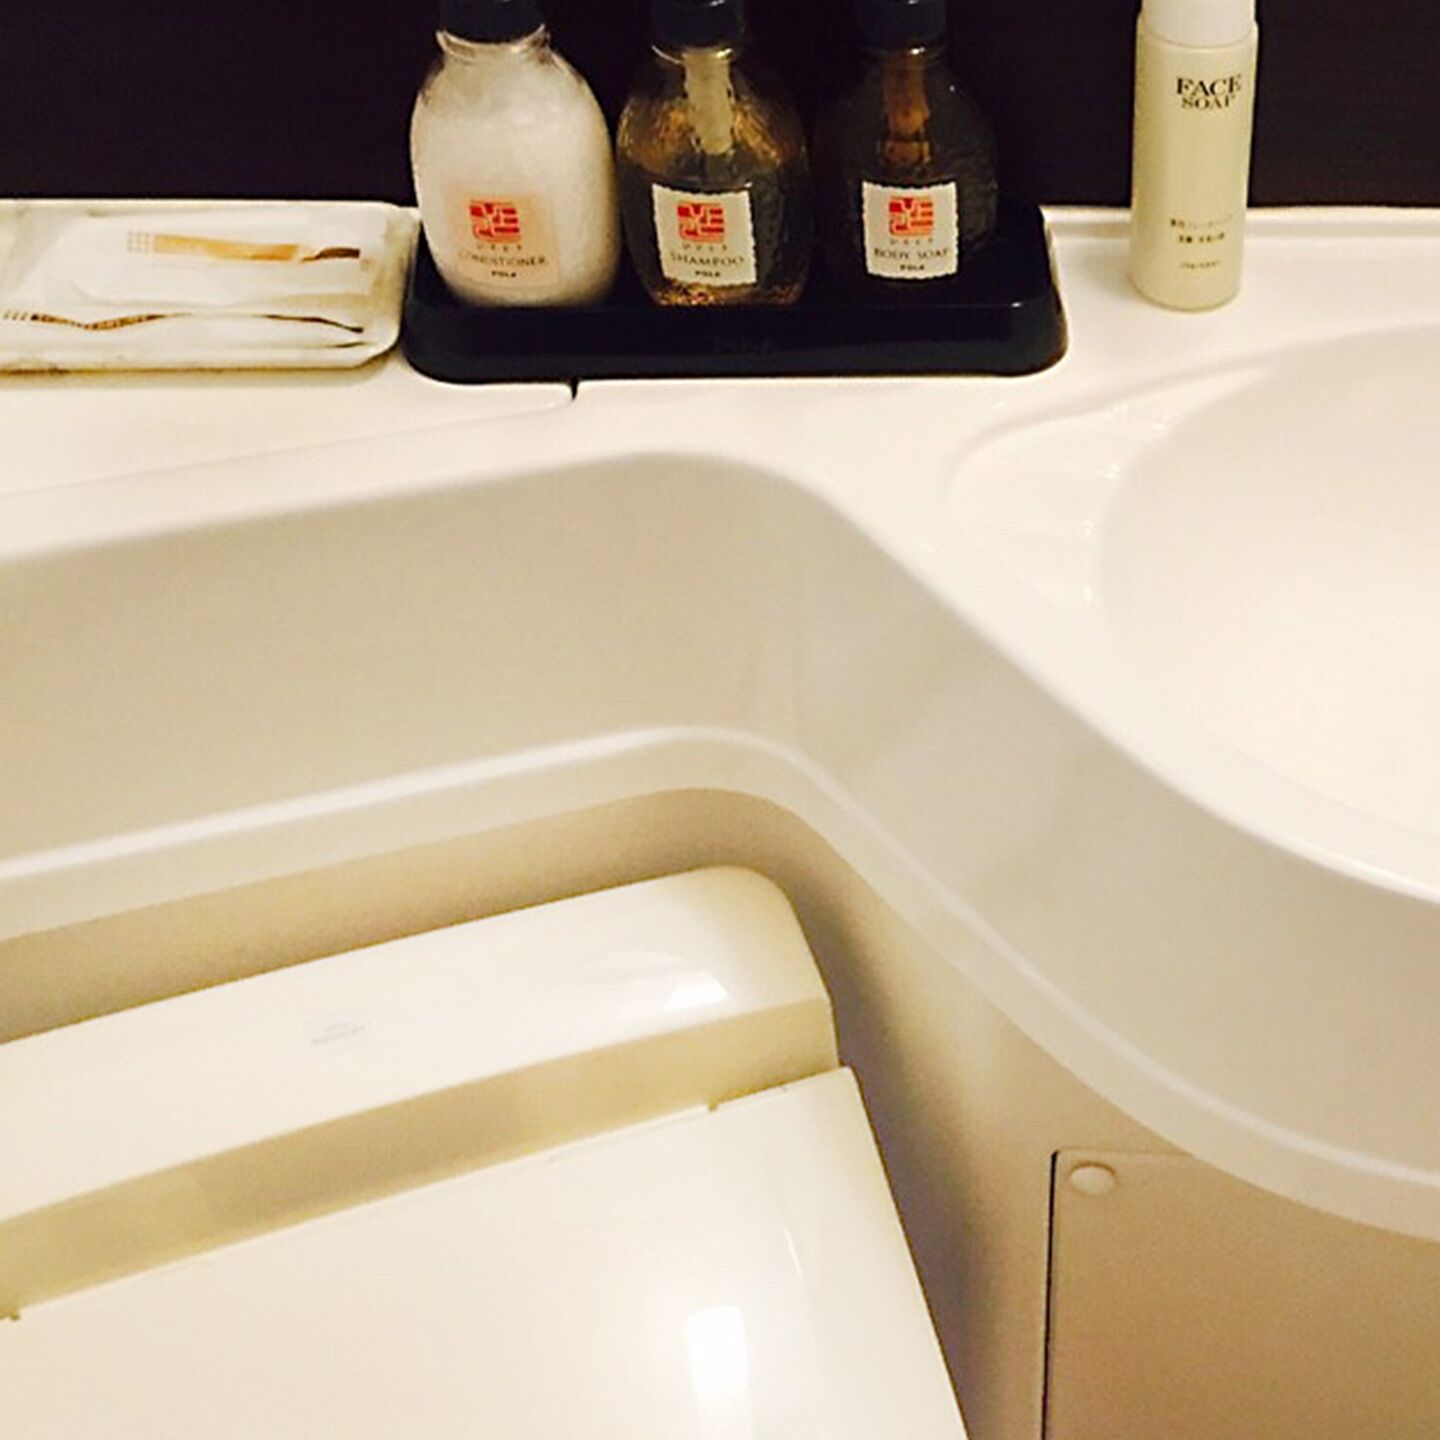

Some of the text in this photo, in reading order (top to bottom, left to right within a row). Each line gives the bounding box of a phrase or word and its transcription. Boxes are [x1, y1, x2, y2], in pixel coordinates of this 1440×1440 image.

[1177, 74, 1241, 96] FACE
[1181, 94, 1236, 110] SOAP
[669, 251, 745, 266] SHAMPOO
[874, 248, 909, 259] BODY
